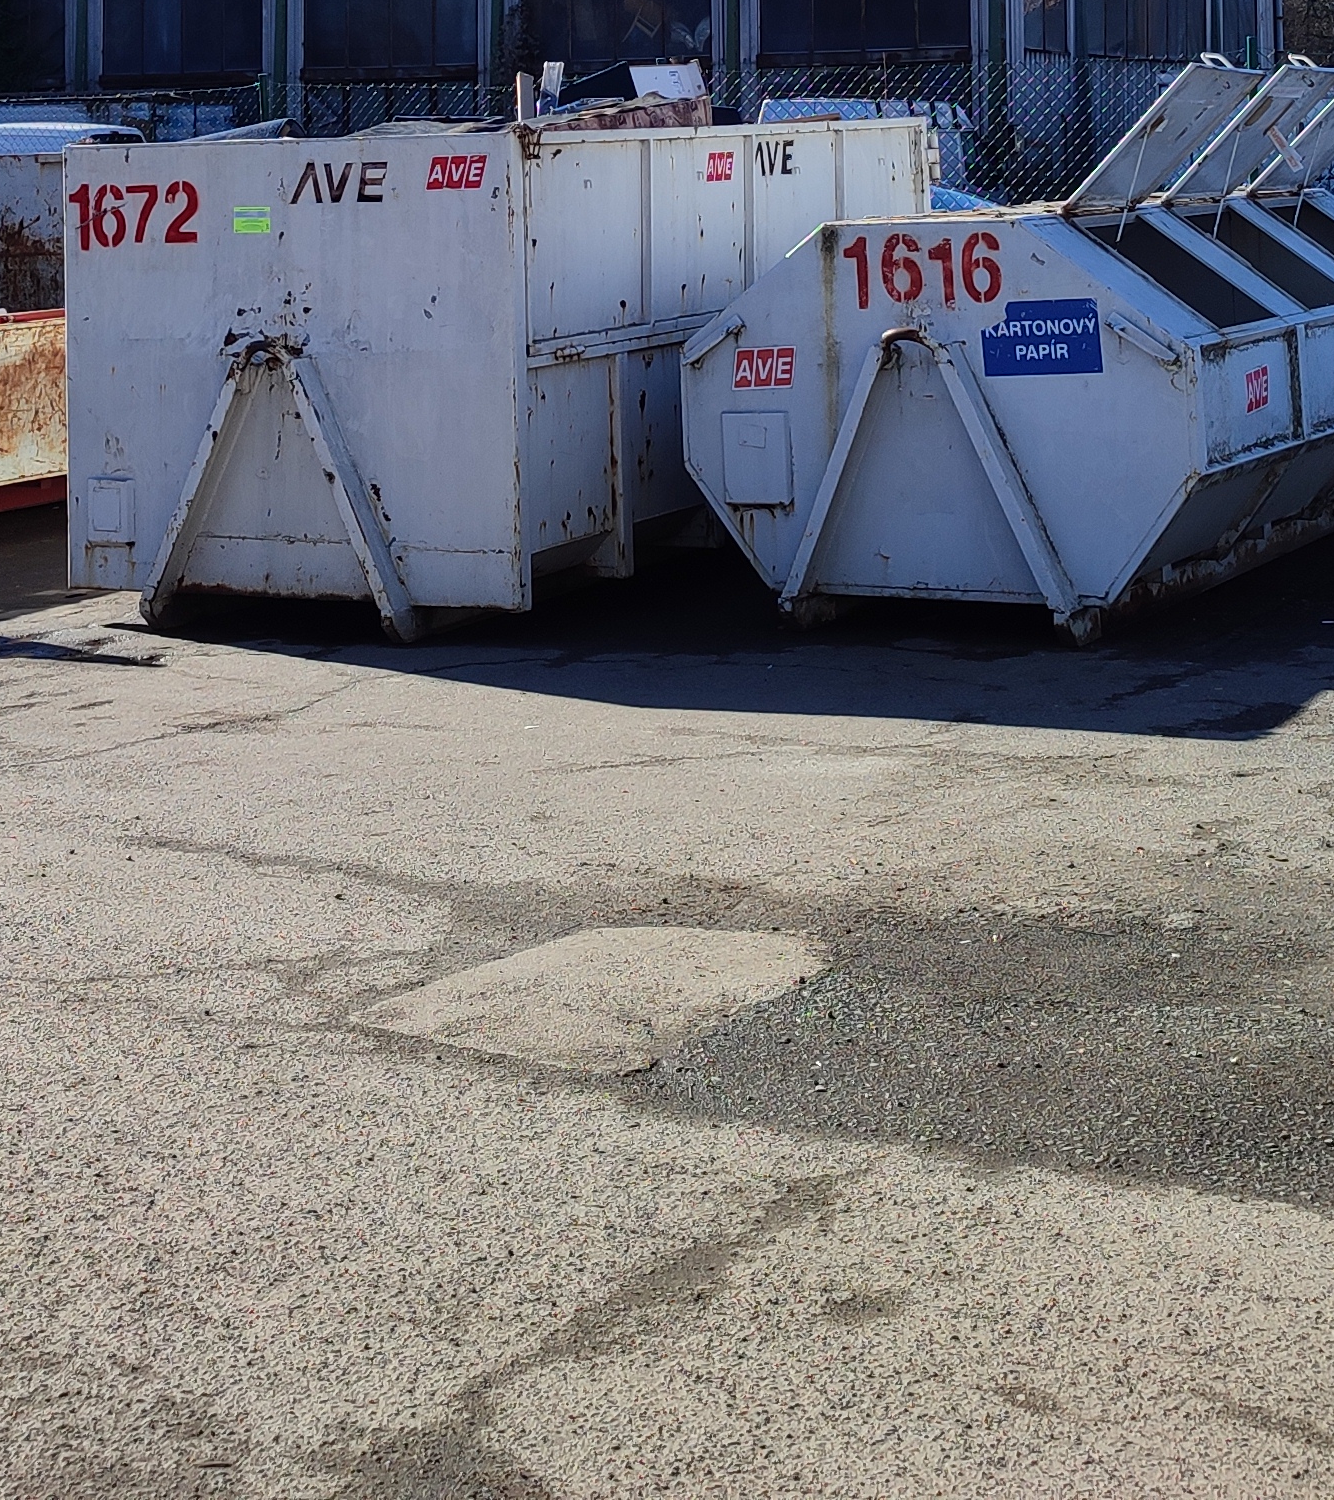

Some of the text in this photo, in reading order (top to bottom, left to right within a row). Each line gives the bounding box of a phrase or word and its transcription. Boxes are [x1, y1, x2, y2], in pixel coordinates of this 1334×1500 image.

[755, 140, 795, 177] AVE
[288, 161, 388, 205] AVE
[68, 180, 198, 252] 1672
[843, 231, 1002, 310] 1616
[985, 312, 1096, 339] KARTONOVÝ
[1015, 339, 1069, 361] PAPÍR
[735, 356, 792, 382] AVE
